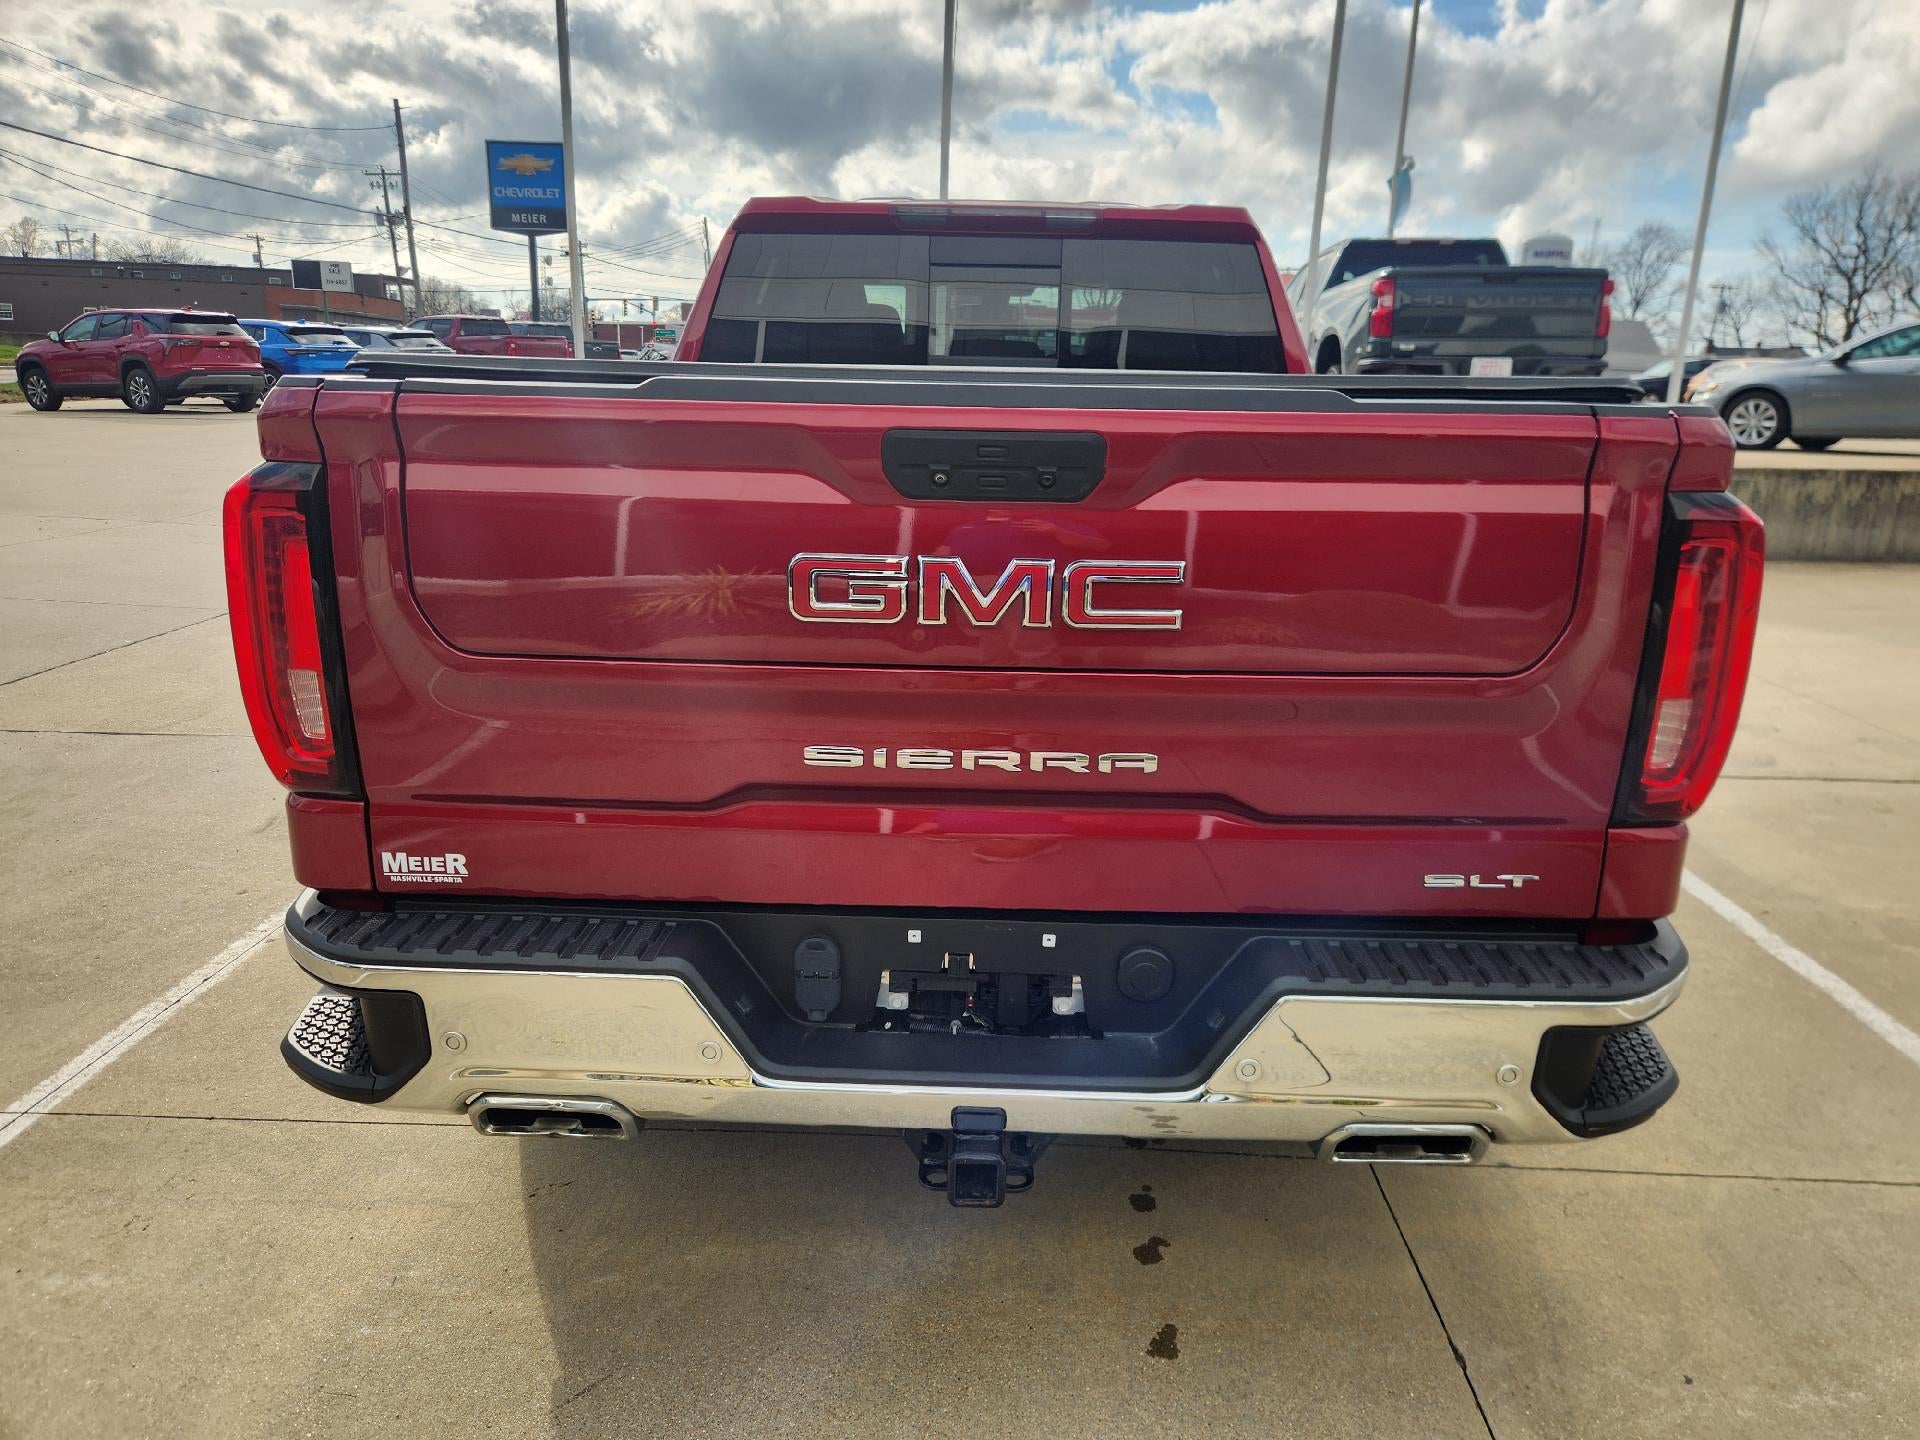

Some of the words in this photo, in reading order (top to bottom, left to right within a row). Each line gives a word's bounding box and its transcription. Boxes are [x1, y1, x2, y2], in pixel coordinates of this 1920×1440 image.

[494, 186, 560, 199] CHEVROLET
[511, 213, 547, 224] MEIER
[787, 552, 1186, 630] GMC
[803, 745, 1158, 774] SIERRA
[381, 851, 469, 875] MEIER
[390, 875, 463, 884] NASHVILLE-SPARTA
[1423, 874, 1540, 889] SLT
